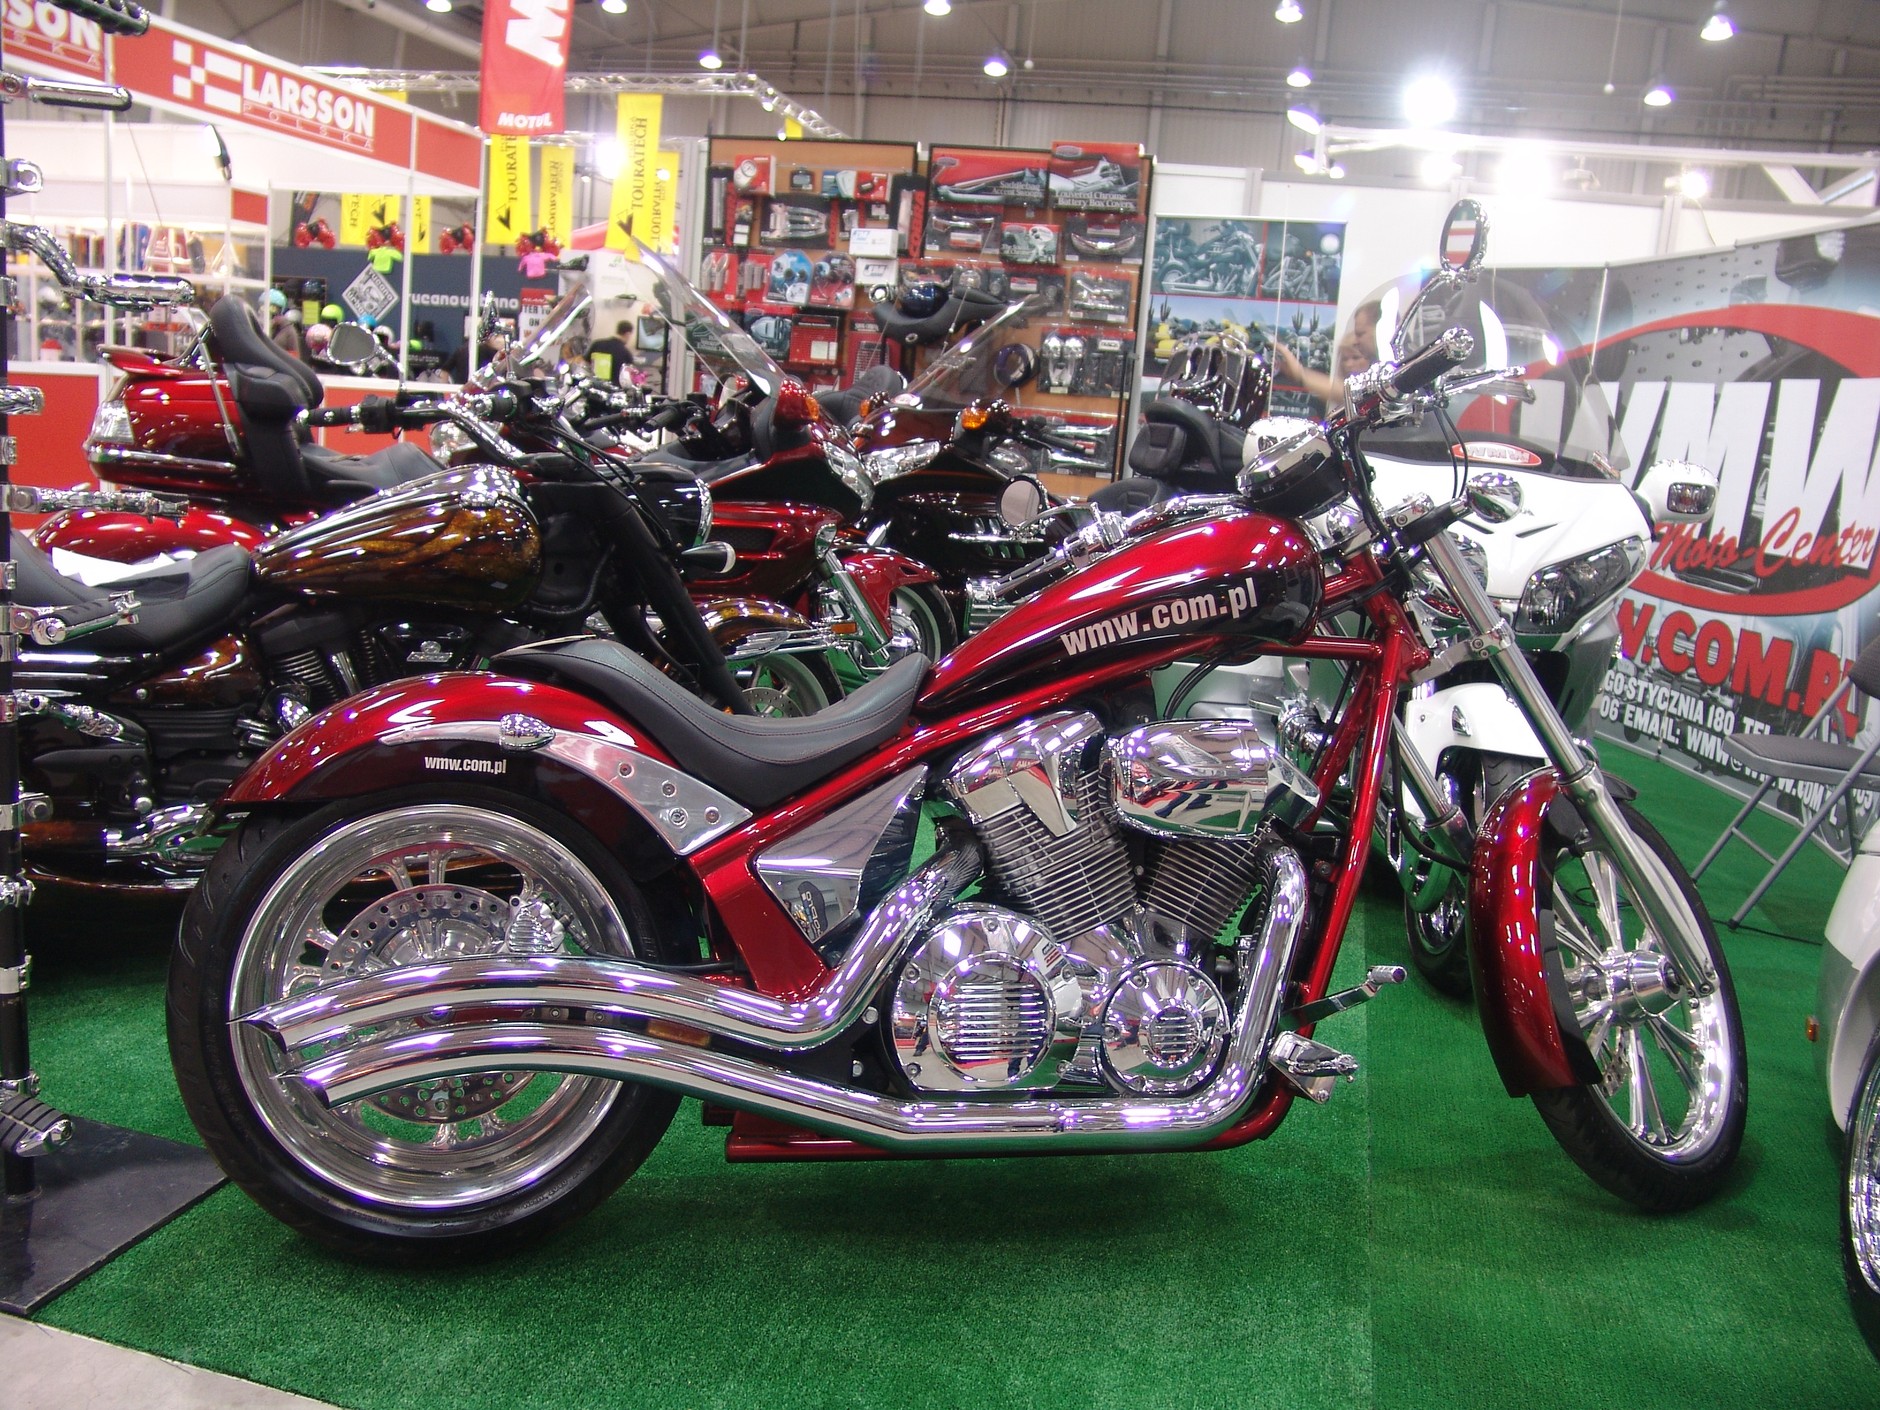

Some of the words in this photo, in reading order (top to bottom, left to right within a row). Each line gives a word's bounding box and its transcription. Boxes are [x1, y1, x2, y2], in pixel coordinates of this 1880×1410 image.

[243, 63, 375, 138] LARSSON
[243, 102, 374, 150] POLSKA
[497, 112, 553, 129] MOTUL
[505, 134, 520, 204] TOURATE
[631, 117, 649, 211] TOURATECH
[1060, 577, 1258, 656] wmw.com.pl
[1707, 704, 1736, 736] 180
[424, 756, 507, 775] wmw.com.pl
